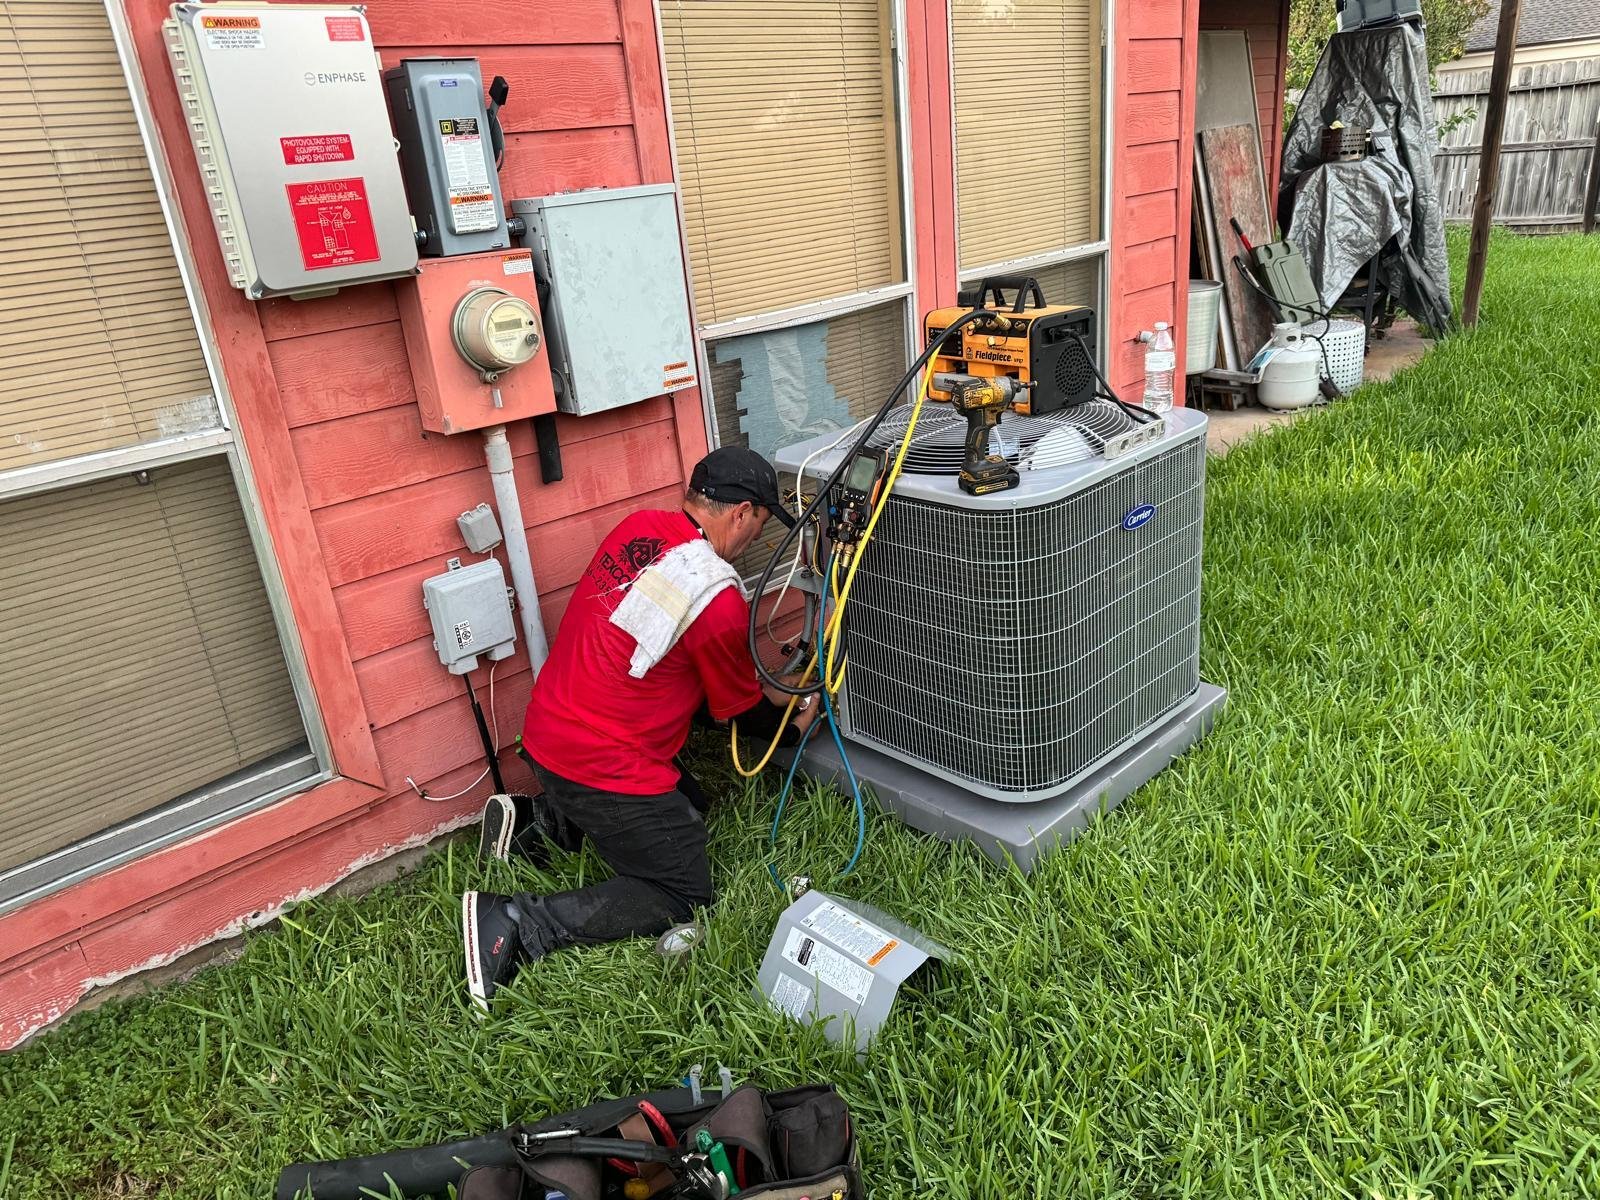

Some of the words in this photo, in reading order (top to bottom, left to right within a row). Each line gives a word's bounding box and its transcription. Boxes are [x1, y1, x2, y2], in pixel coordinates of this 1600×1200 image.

[214, 18, 258, 27] WARNING
[317, 72, 366, 83] ENPHASE
[282, 138, 325, 147] PHOTOVOLTAIC
[325, 136, 349, 145] SYSTEM
[296, 146, 324, 154] EQUIPPED
[294, 154, 312, 162] RAPID
[313, 153, 344, 161] SHUTDOWN
[307, 182, 347, 193] CAUTION
[461, 195, 488, 203] WARNING
[975, 350, 1012, 362] Fieldpiece
[1128, 509, 1152, 526] Carrier
